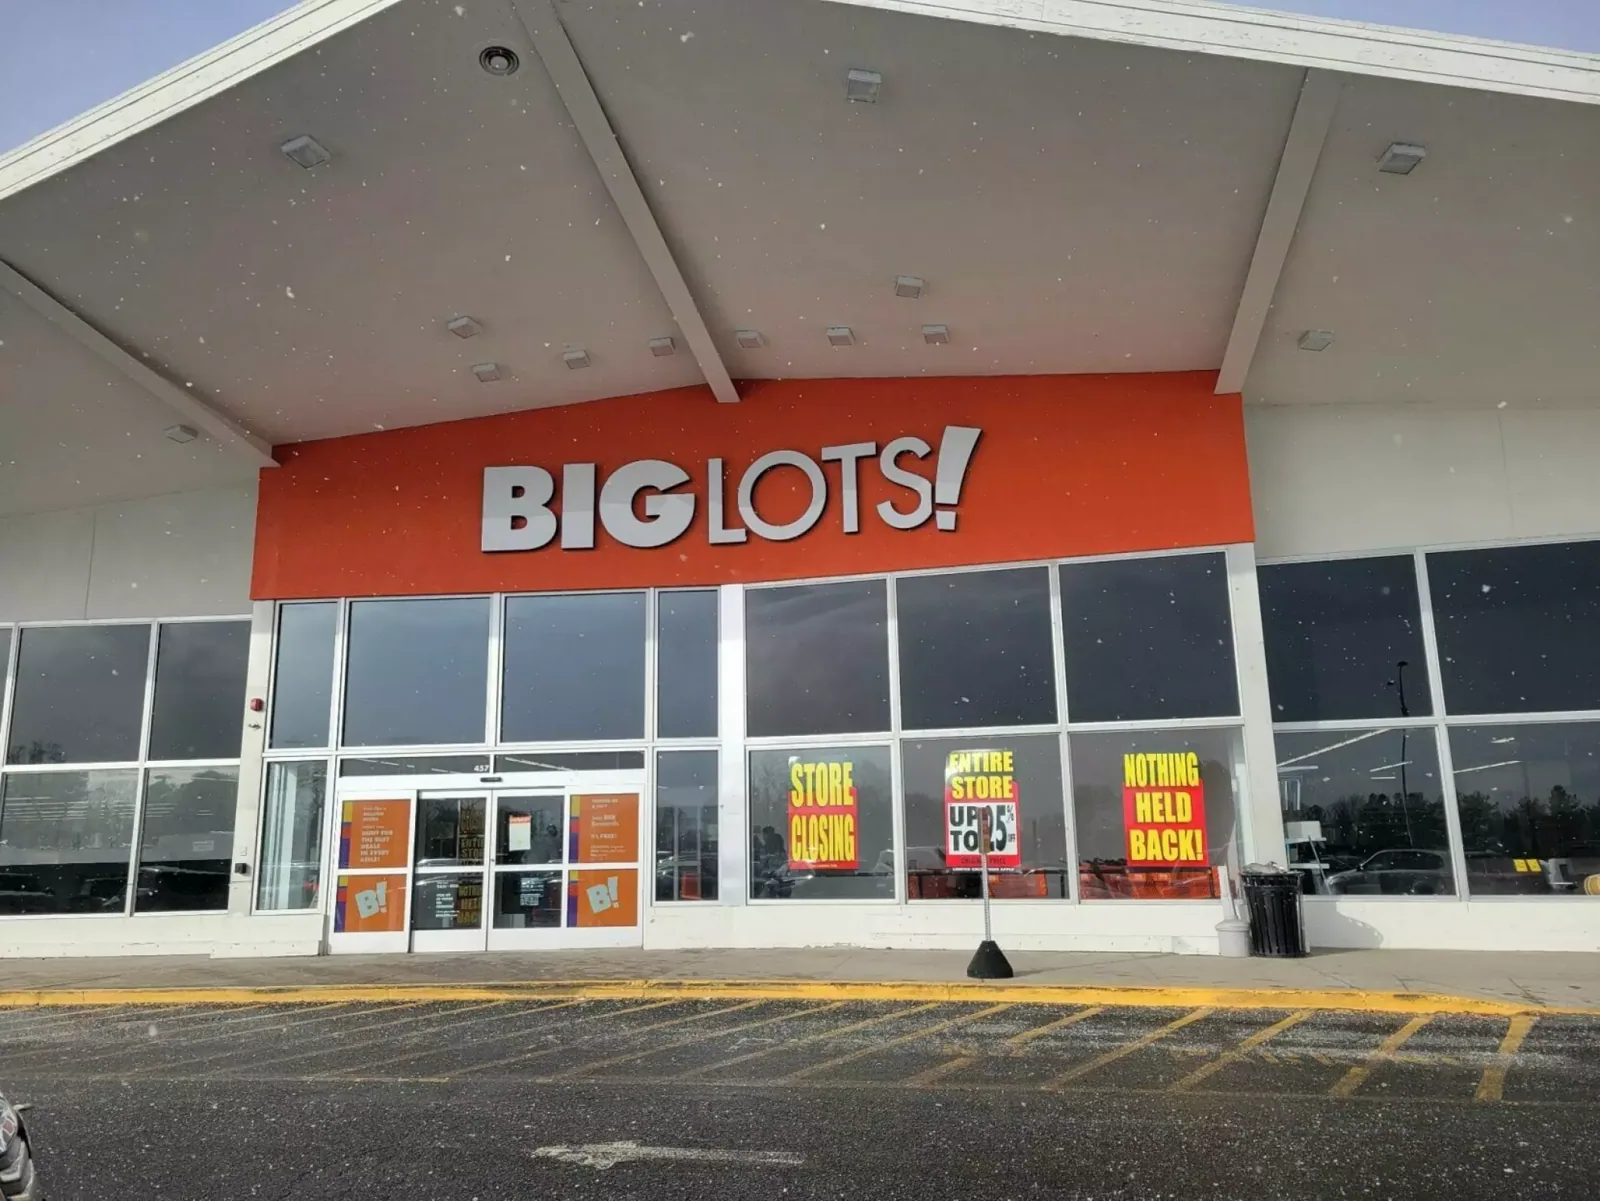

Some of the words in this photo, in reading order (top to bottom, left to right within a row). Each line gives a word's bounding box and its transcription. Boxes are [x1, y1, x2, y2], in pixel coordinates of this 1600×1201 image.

[481, 458, 696, 553] BIG
[707, 425, 983, 546] LOTS!
[474, 764, 490, 772] 457
[949, 751, 1014, 773] ENTIRE
[1124, 752, 1200, 787] NOTHING
[791, 762, 854, 807] STORE
[952, 776, 1014, 799] STORE
[949, 805, 979, 827] UP
[1135, 791, 1193, 823] HELD
[791, 814, 855, 862] CLOSING
[950, 829, 979, 852] TO
[1130, 829, 1204, 861] BACK!
